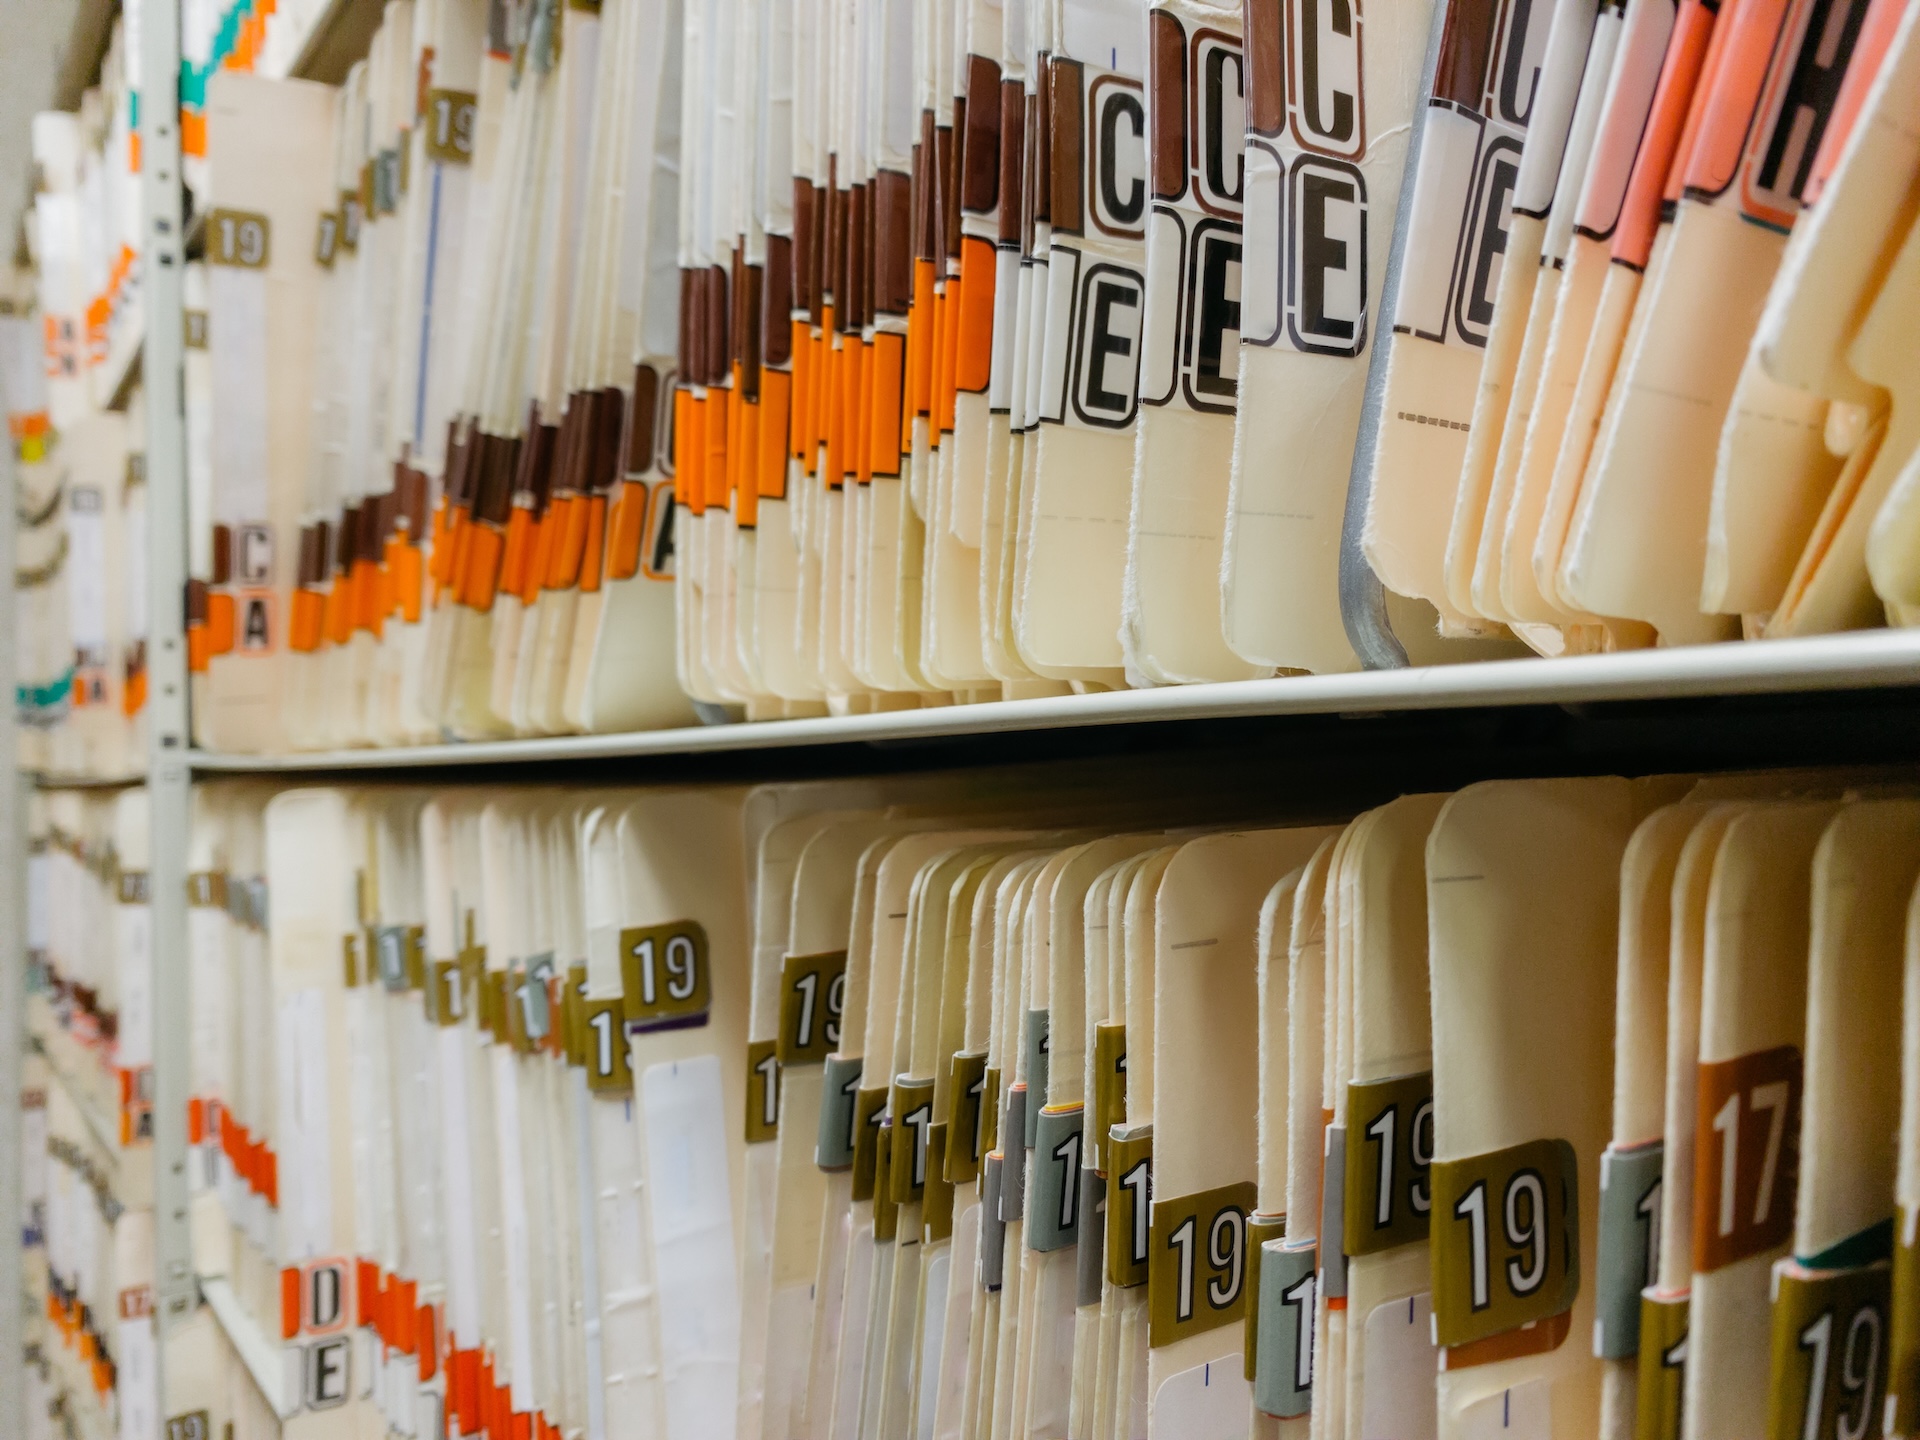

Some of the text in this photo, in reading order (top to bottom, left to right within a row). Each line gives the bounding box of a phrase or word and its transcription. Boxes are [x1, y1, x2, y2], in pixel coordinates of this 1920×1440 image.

[1206, 46, 1243, 201] C
[1303, 0, 1352, 142] C
[1101, 92, 1143, 223] C
[220, 217, 264, 265] 19
[1302, 168, 1355, 339] E
[1084, 281, 1138, 412] E
[1197, 238, 1242, 398] E
[239, 531, 267, 578] C
[244, 599, 269, 646] A
[384, 934, 400, 977] 1
[443, 968, 461, 1016] 1
[632, 935, 697, 1004] 19
[795, 971, 845, 1046] 19
[755, 1053, 778, 1124] 1
[902, 1101, 932, 1188] 1
[1053, 1131, 1083, 1231] 1
[1365, 1096, 1432, 1230] 19
[1712, 1081, 1789, 1237] 17
[1119, 1158, 1149, 1266] 1
[1168, 1204, 1246, 1323] 19
[1454, 1167, 1549, 1313] 19
[313, 1267, 340, 1326] D
[1282, 1271, 1315, 1392] 1
[317, 1342, 343, 1402] E
[1799, 1308, 1882, 1440] 19
